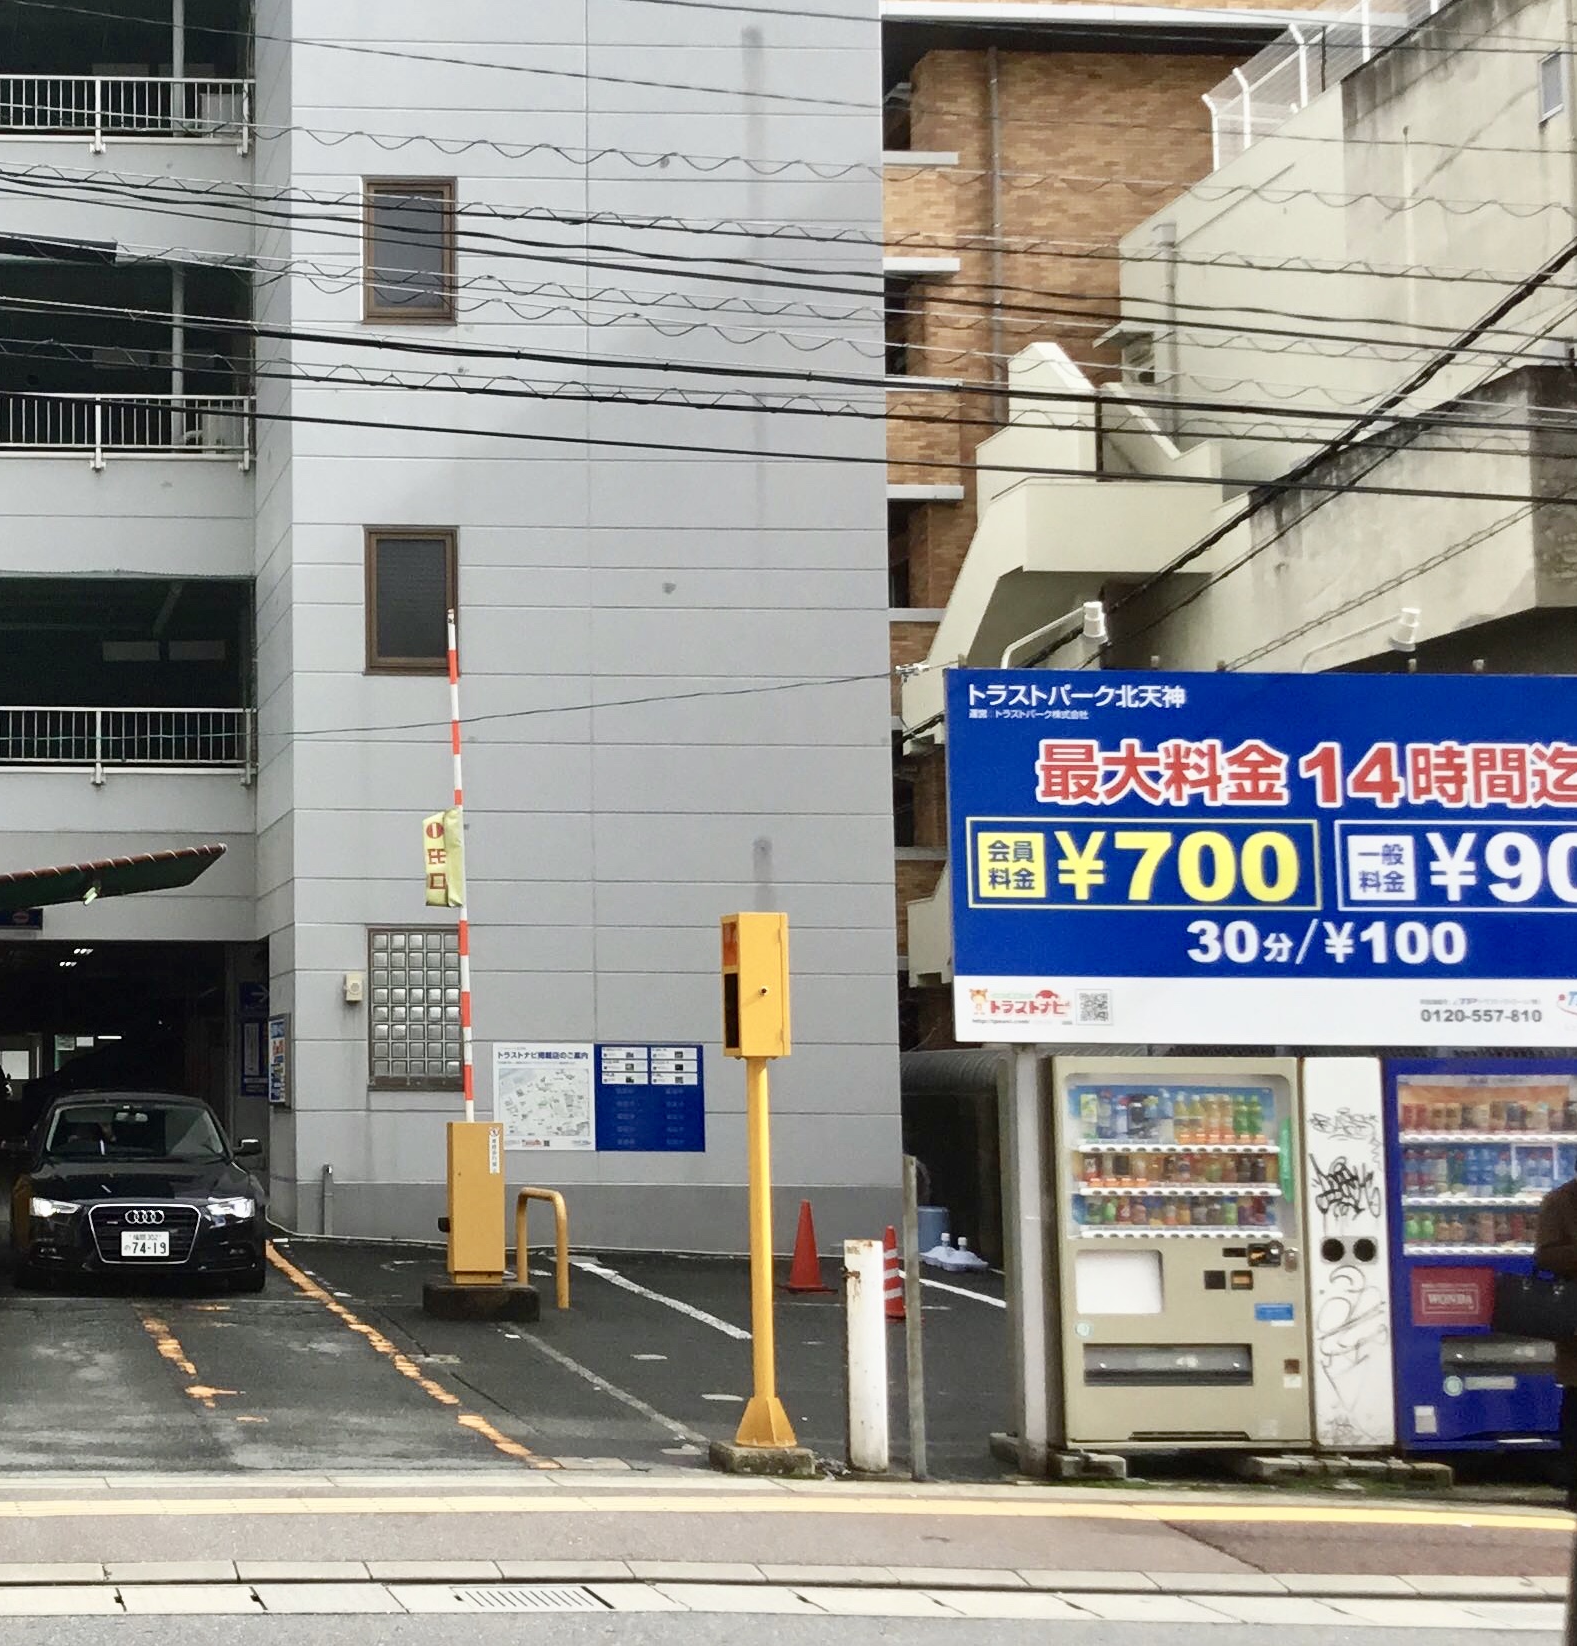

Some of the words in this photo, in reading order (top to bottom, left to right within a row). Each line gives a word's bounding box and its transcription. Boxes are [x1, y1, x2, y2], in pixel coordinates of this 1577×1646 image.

[968, 684, 1186, 708] トラストパーク北天神
[988, 840, 1035, 863] 会員
[1359, 843, 1404, 866] 一般
[1054, 831, 1299, 902] ¥700
[988, 868, 1036, 891] 料金
[1359, 869, 1407, 893] 料金
[1420, 1009, 1543, 1023] 0120-557-810
[132, 1241, 167, 1255] 74-19
